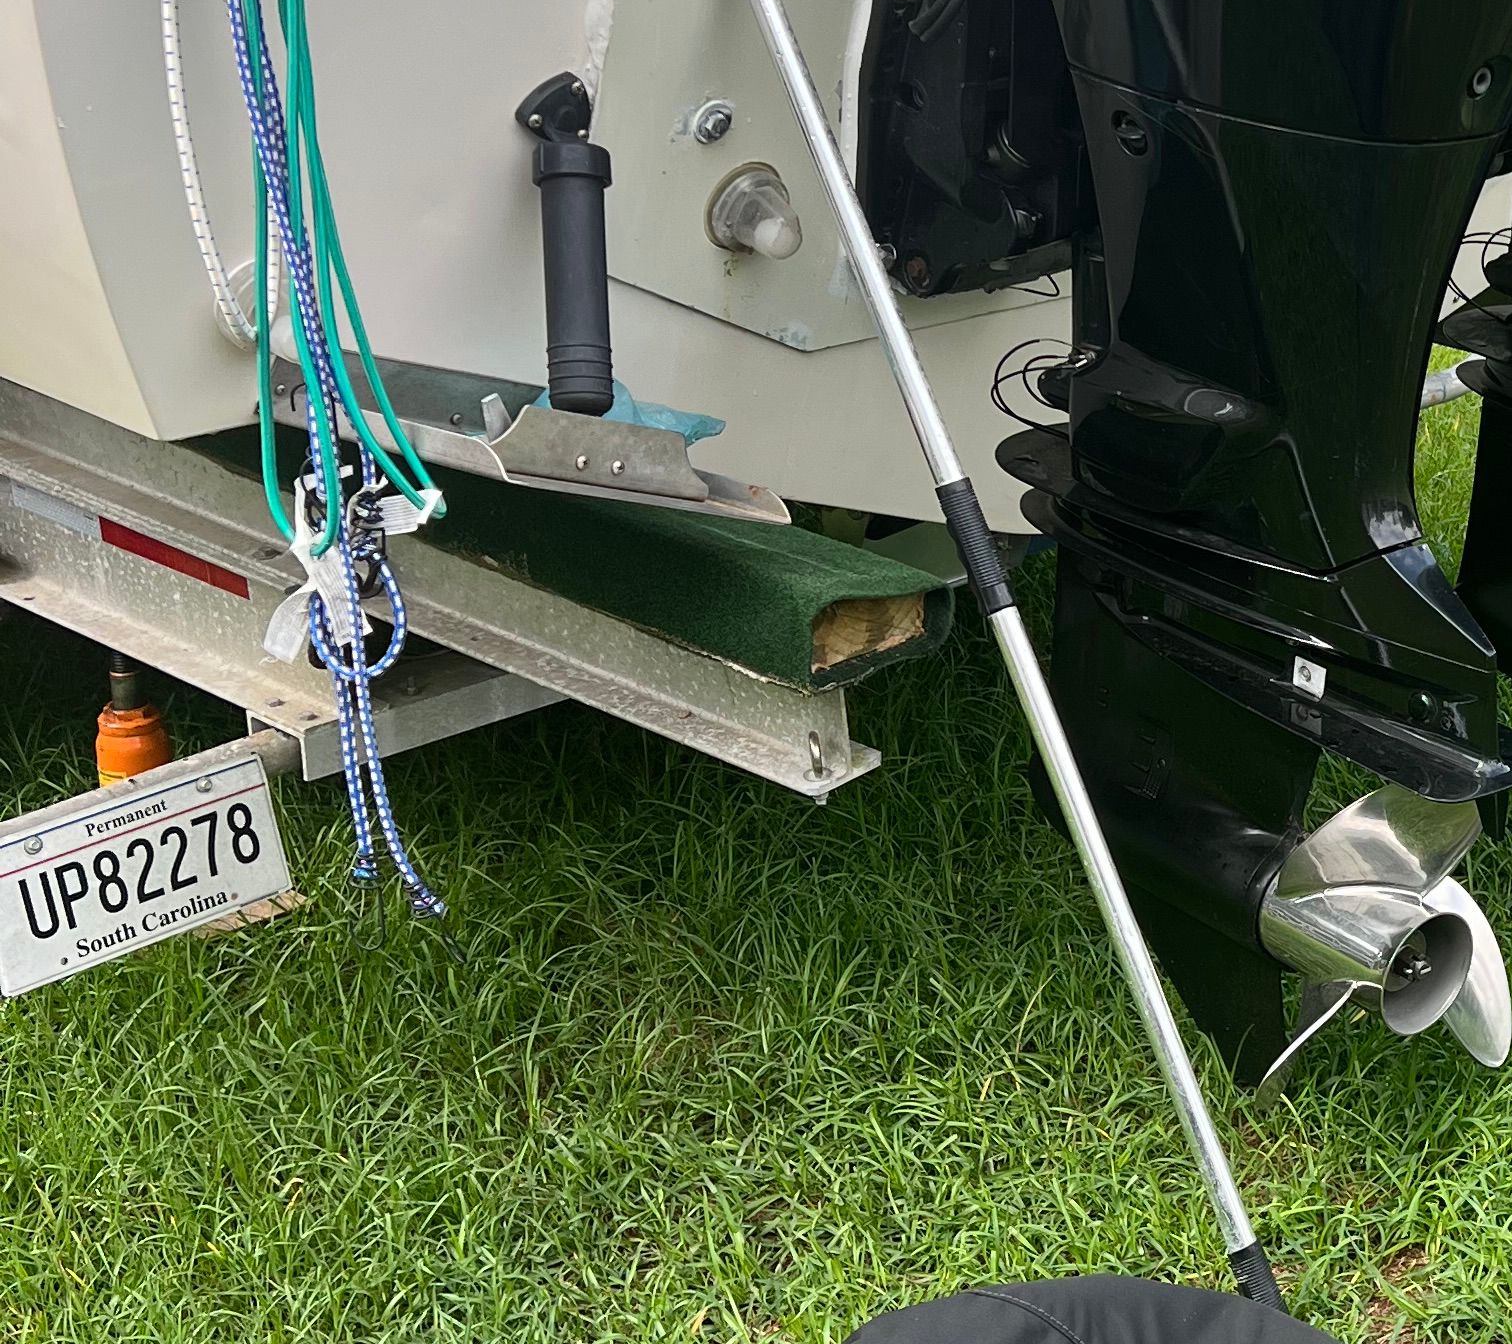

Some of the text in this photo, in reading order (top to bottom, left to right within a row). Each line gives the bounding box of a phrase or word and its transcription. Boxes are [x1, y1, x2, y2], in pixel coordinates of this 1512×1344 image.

[85, 799, 168, 837] Permanent
[18, 802, 261, 940] UP82278
[75, 891, 229, 958] South Carolina
